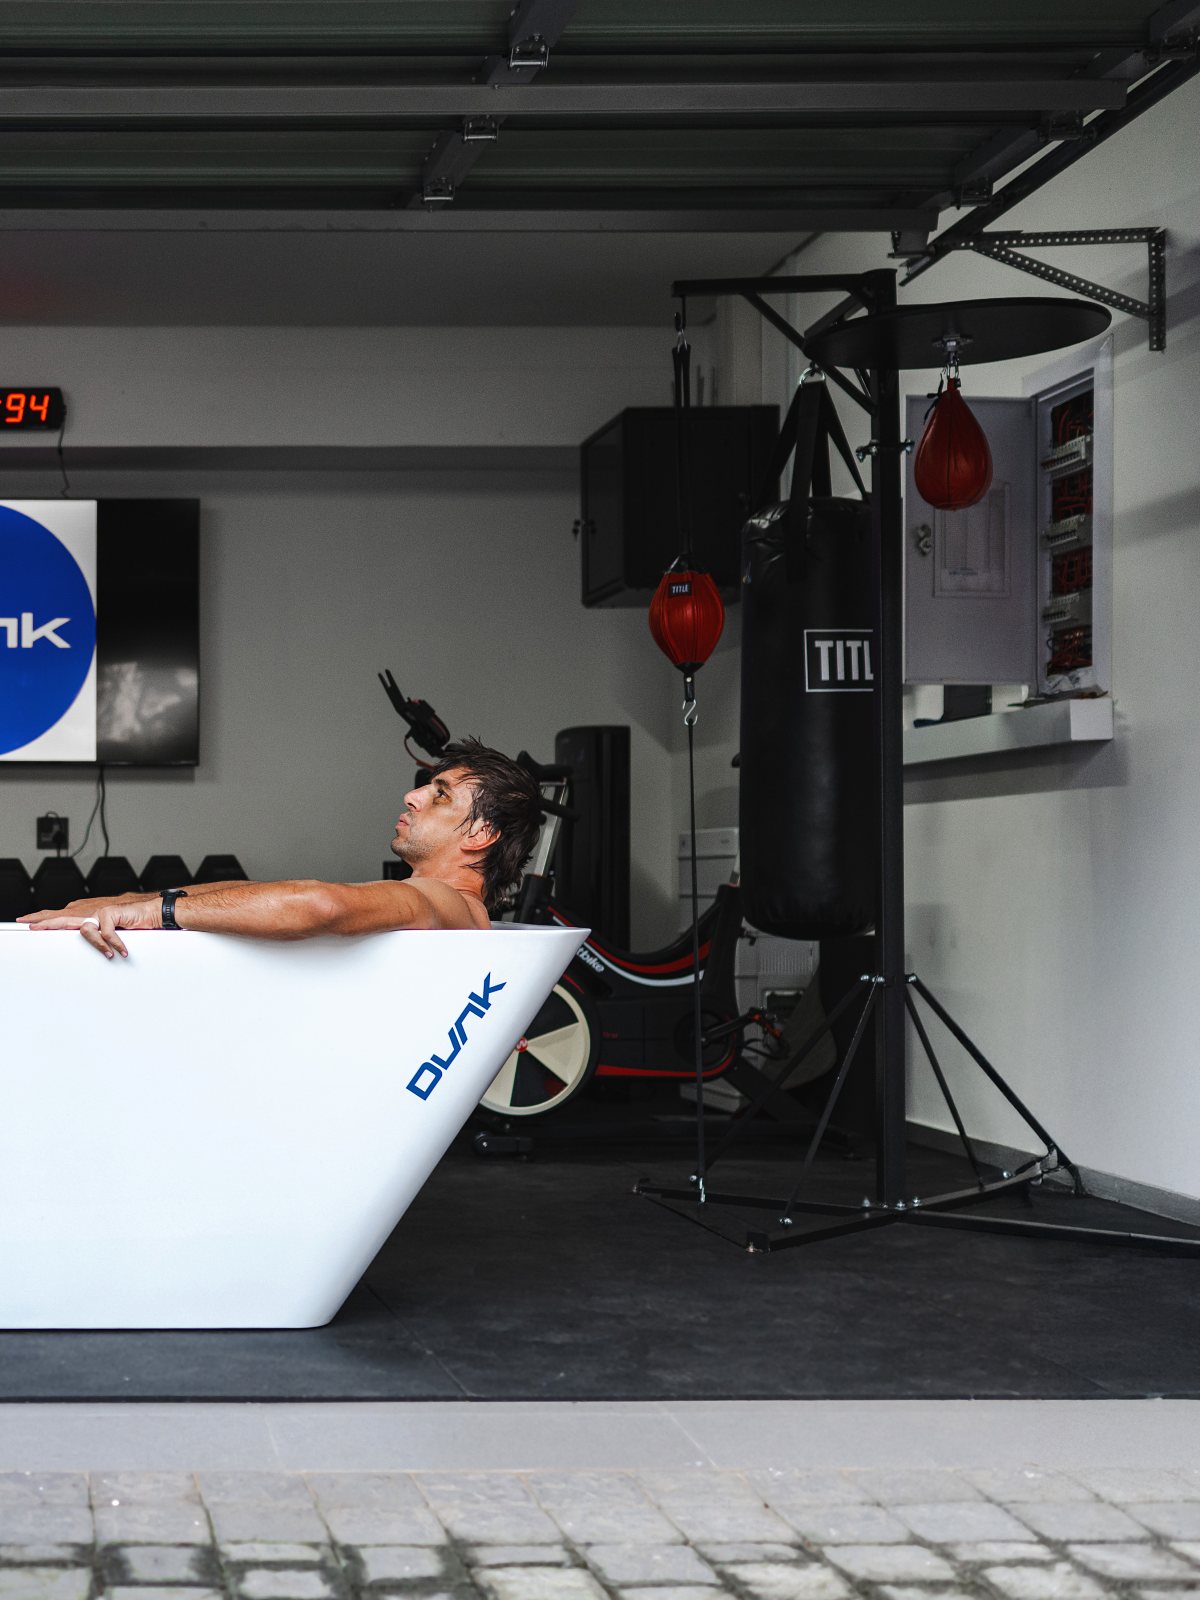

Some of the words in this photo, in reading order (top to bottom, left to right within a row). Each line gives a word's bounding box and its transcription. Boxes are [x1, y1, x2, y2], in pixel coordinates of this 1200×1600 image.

[671, 583, 689, 595] TITLE
[814, 640, 874, 681] TITL
[576, 947, 605, 974] tbike
